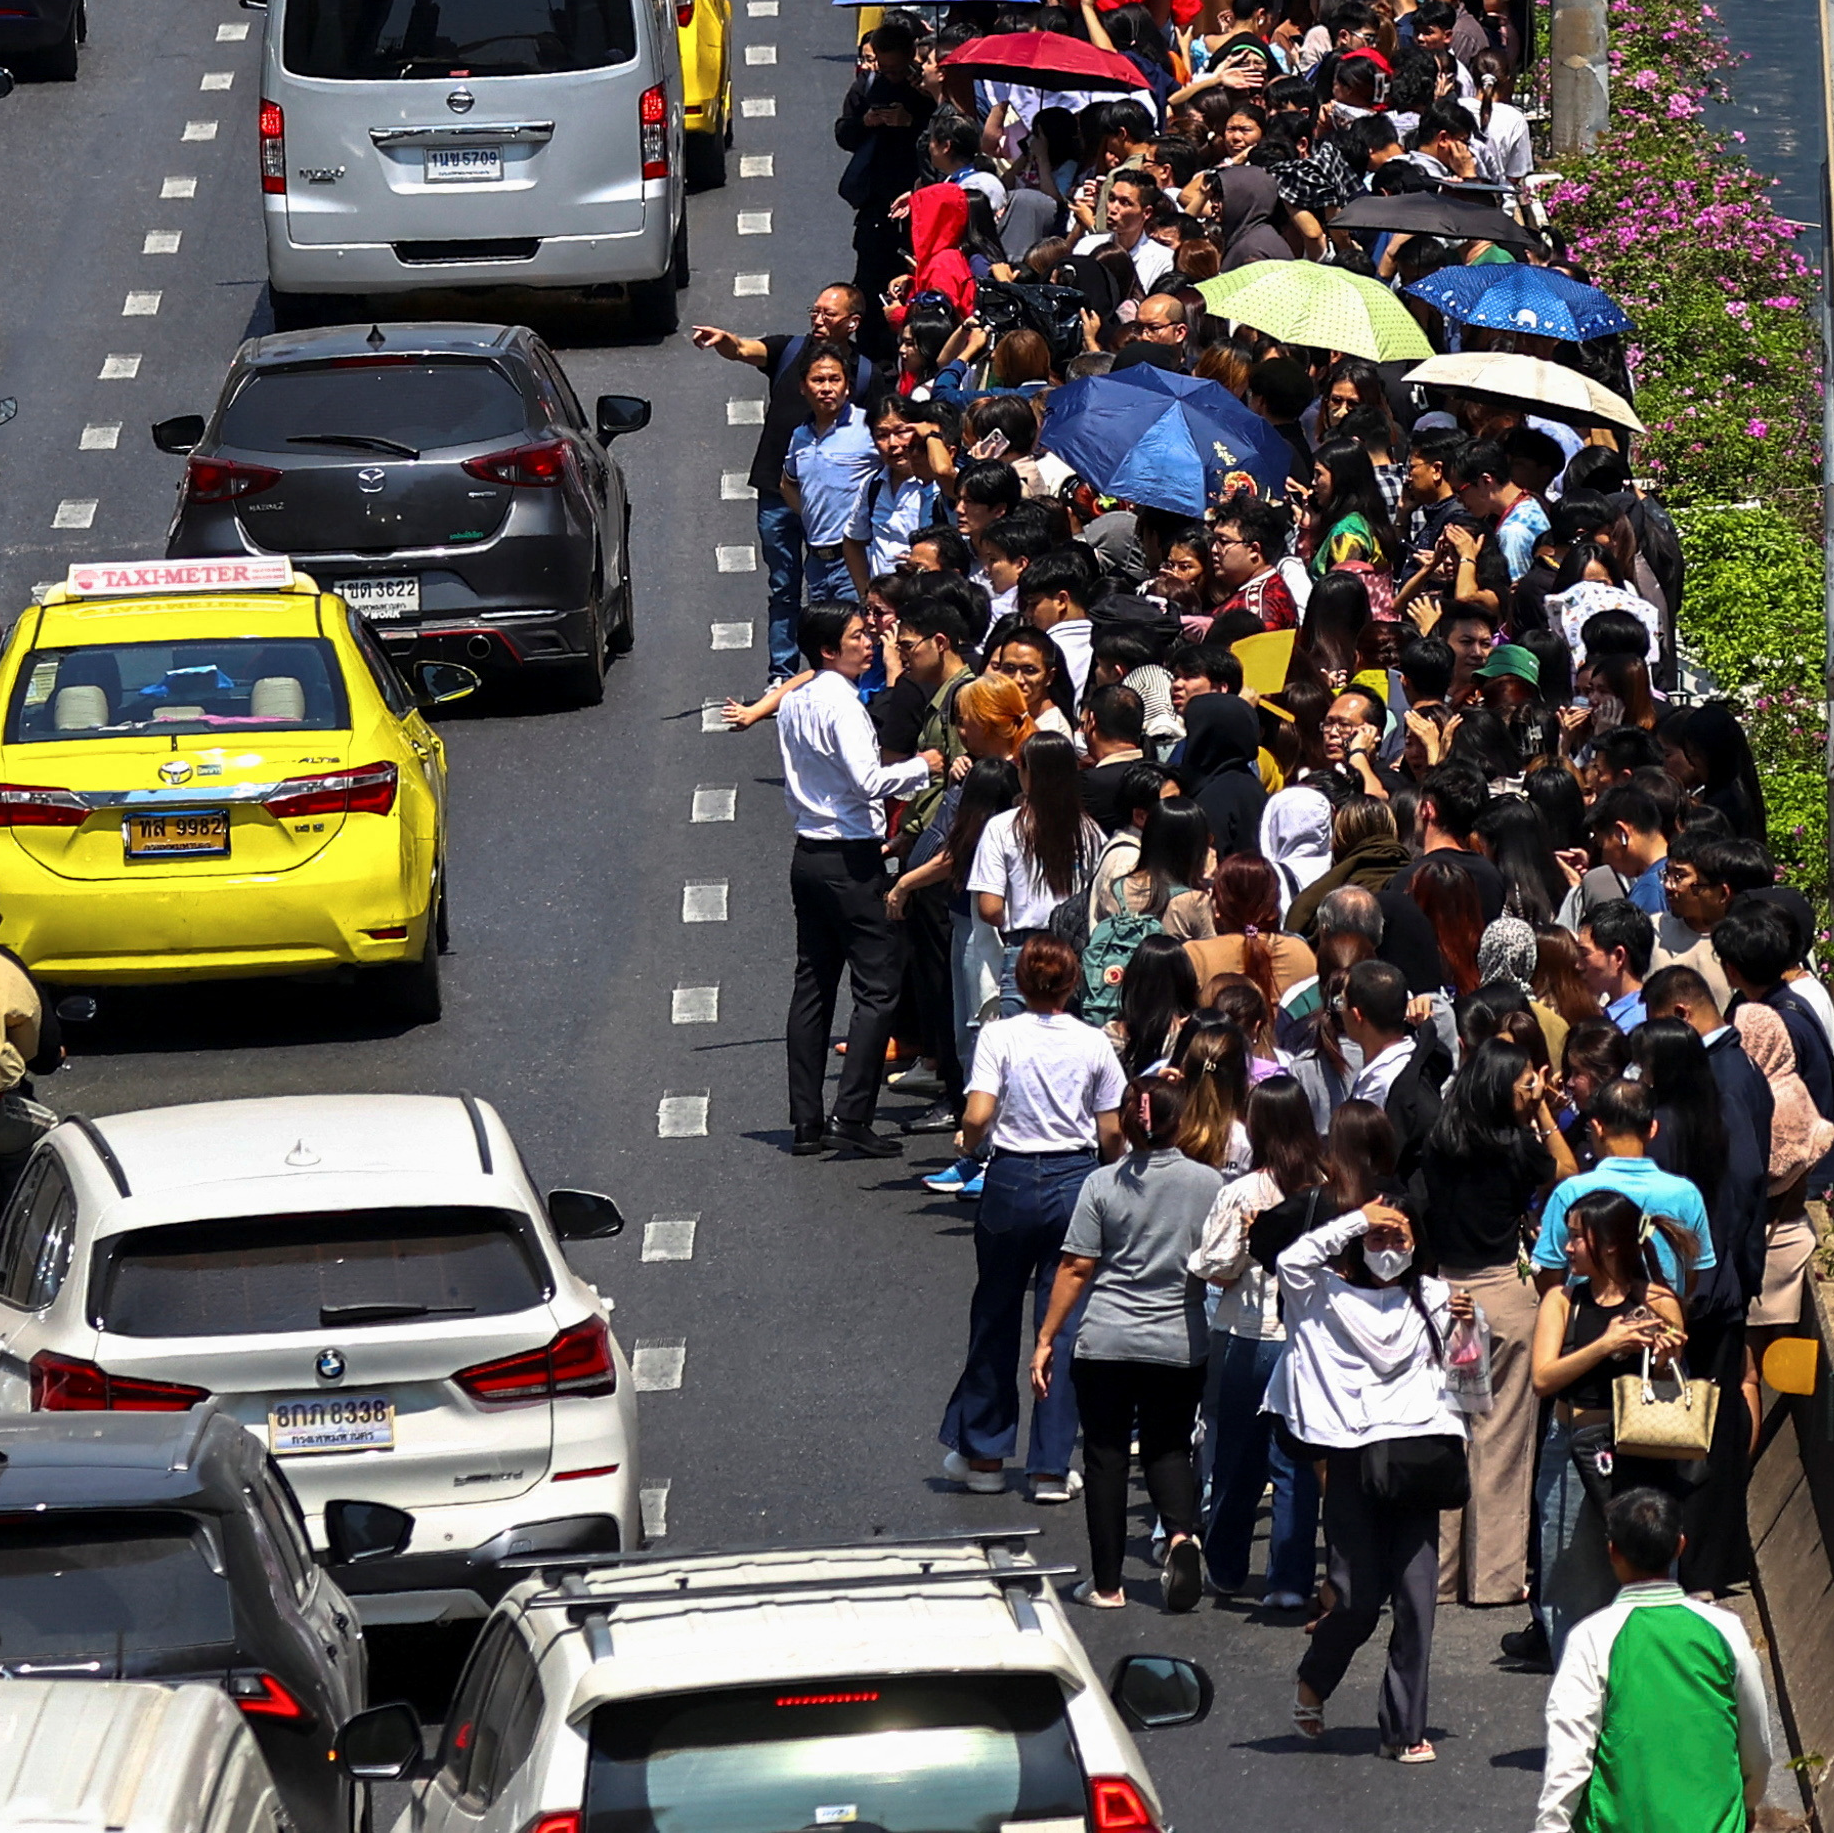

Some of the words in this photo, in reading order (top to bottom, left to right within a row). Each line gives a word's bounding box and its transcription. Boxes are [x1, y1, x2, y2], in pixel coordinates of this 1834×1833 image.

[106, 565, 250, 588] TAXI-METER
[373, 579, 416, 598] 3622
[175, 817, 224, 836] 9982
[328, 1399, 387, 1425] 8338
